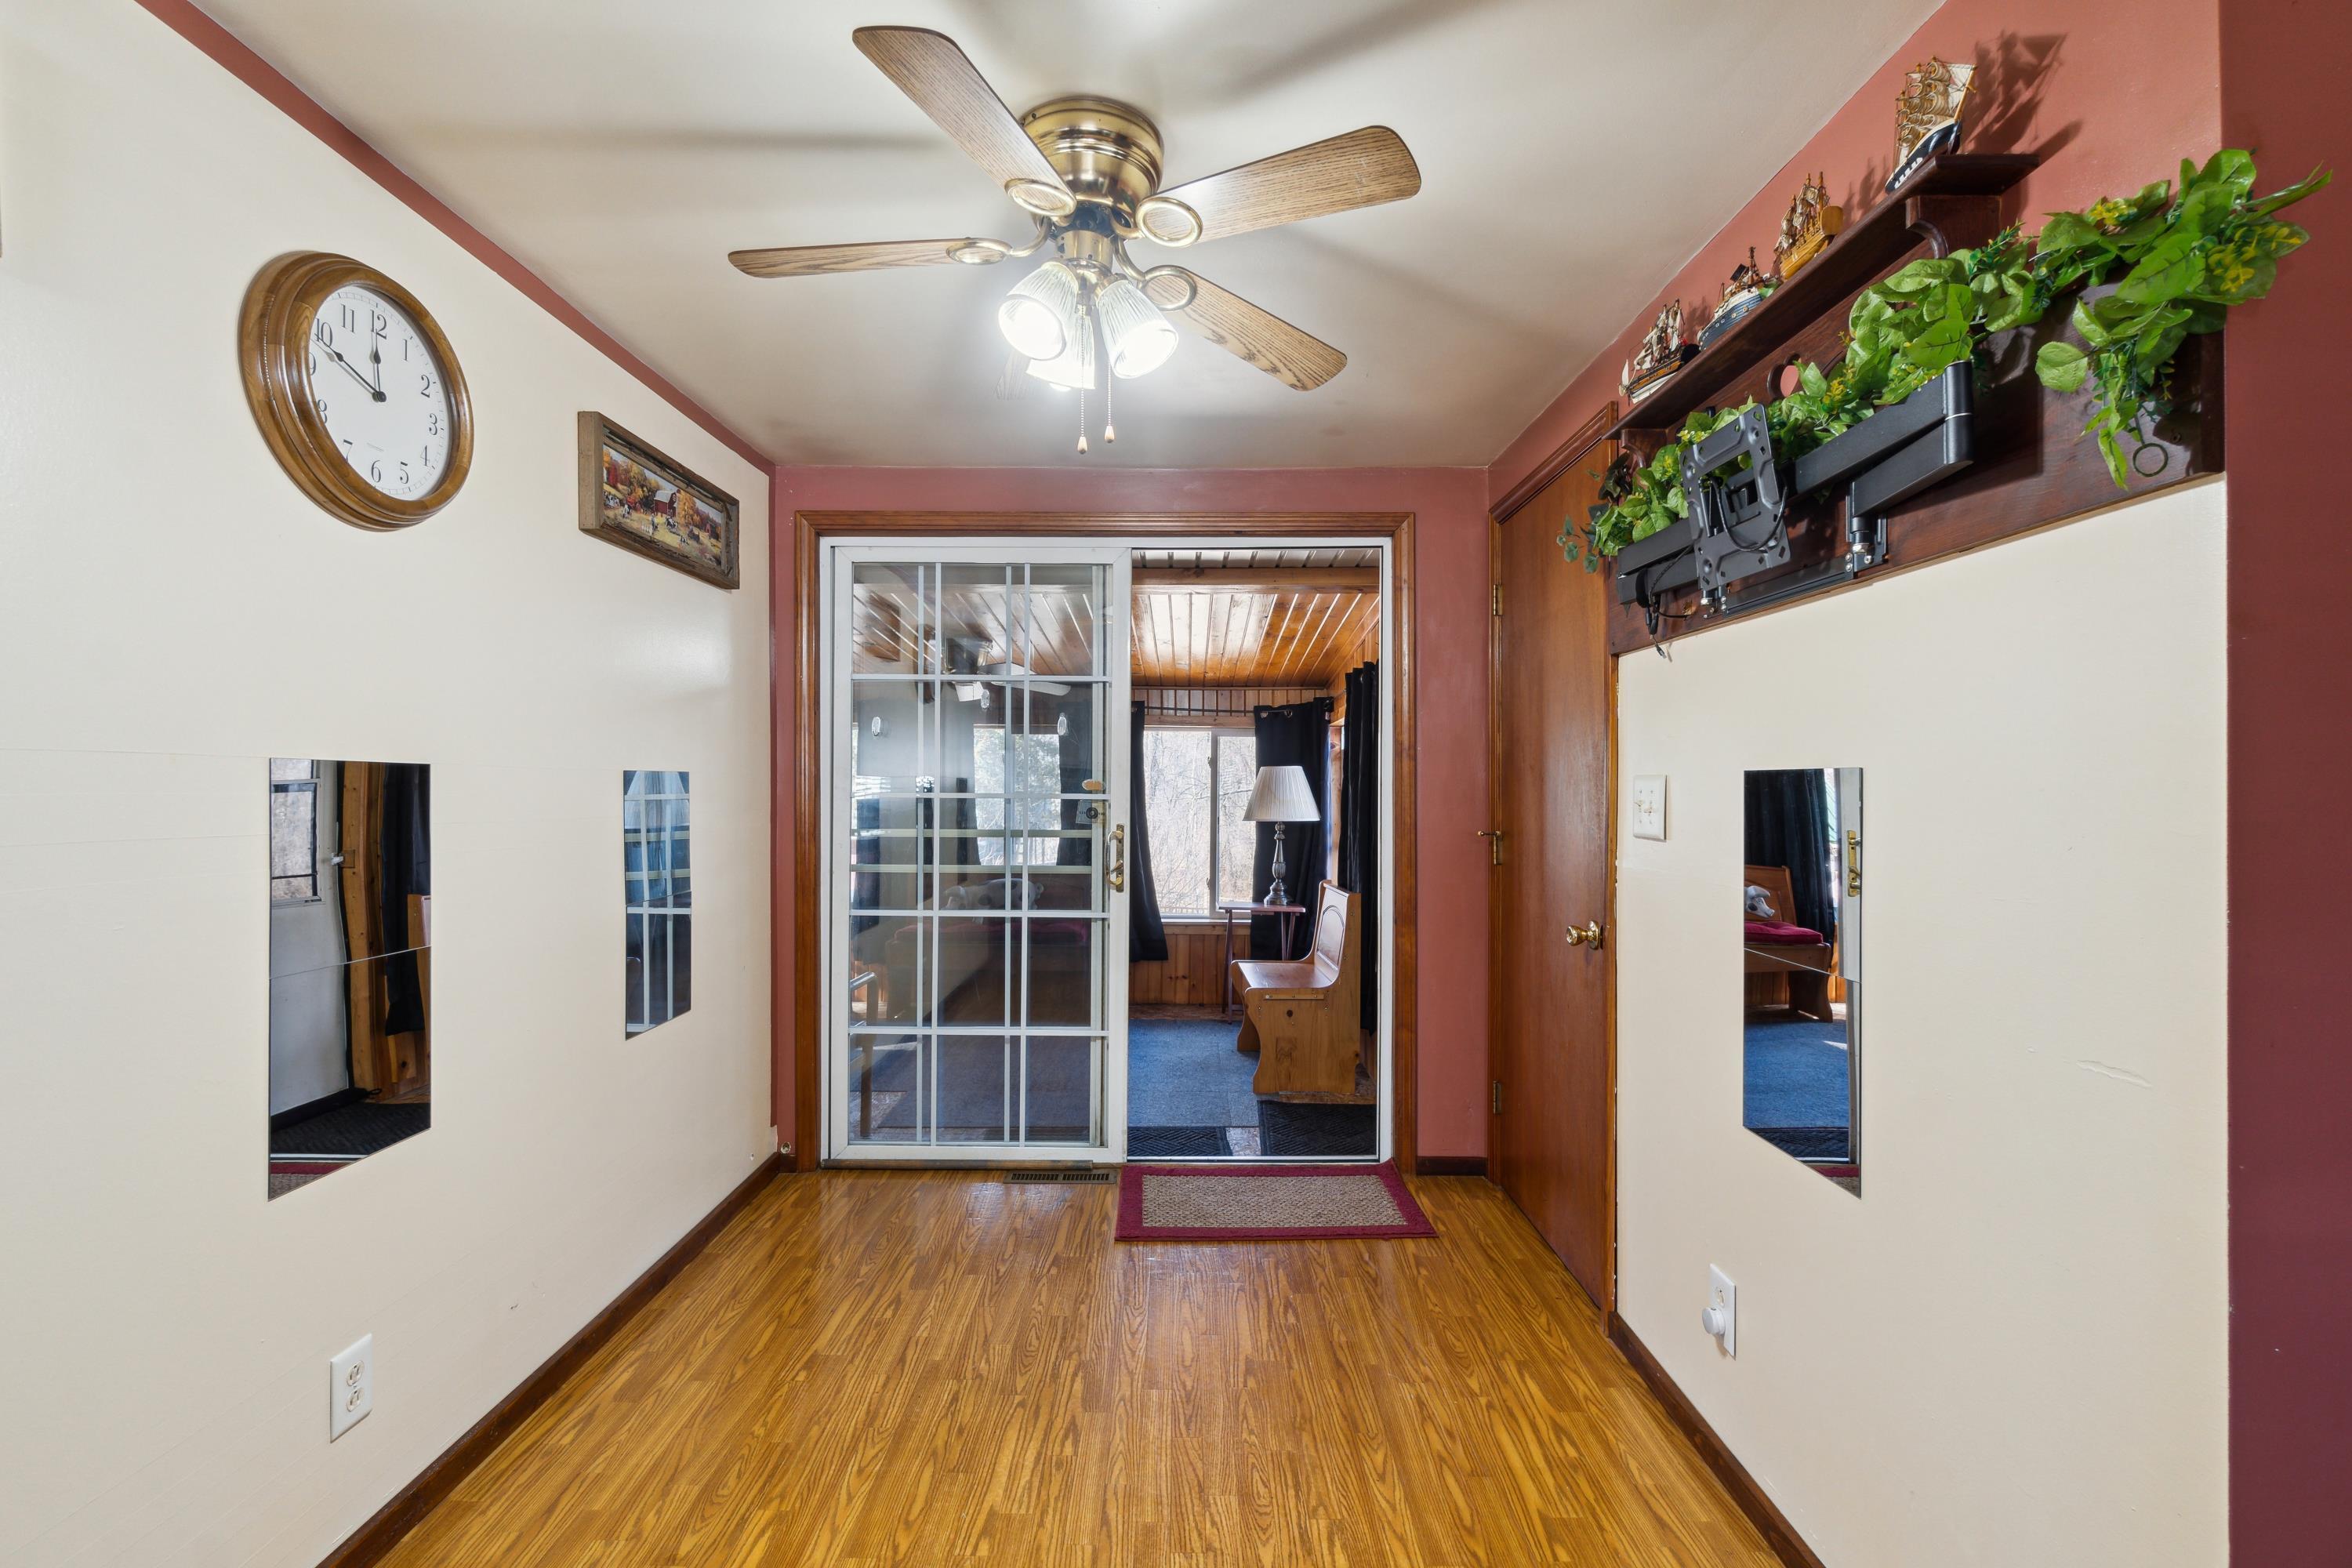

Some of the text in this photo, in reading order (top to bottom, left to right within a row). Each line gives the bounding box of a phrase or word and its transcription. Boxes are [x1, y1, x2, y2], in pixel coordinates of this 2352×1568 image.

[340, 303, 355, 334] 11
[369, 309, 387, 339] 12
[315, 318, 333, 347] 10
[403, 339, 408, 362] 1
[420, 374, 430, 398] 2
[429, 413, 438, 436] 3
[343, 438, 354, 463] 7
[419, 445, 430, 466] 4
[371, 459, 382, 483] 6
[399, 461, 409, 485] 5
